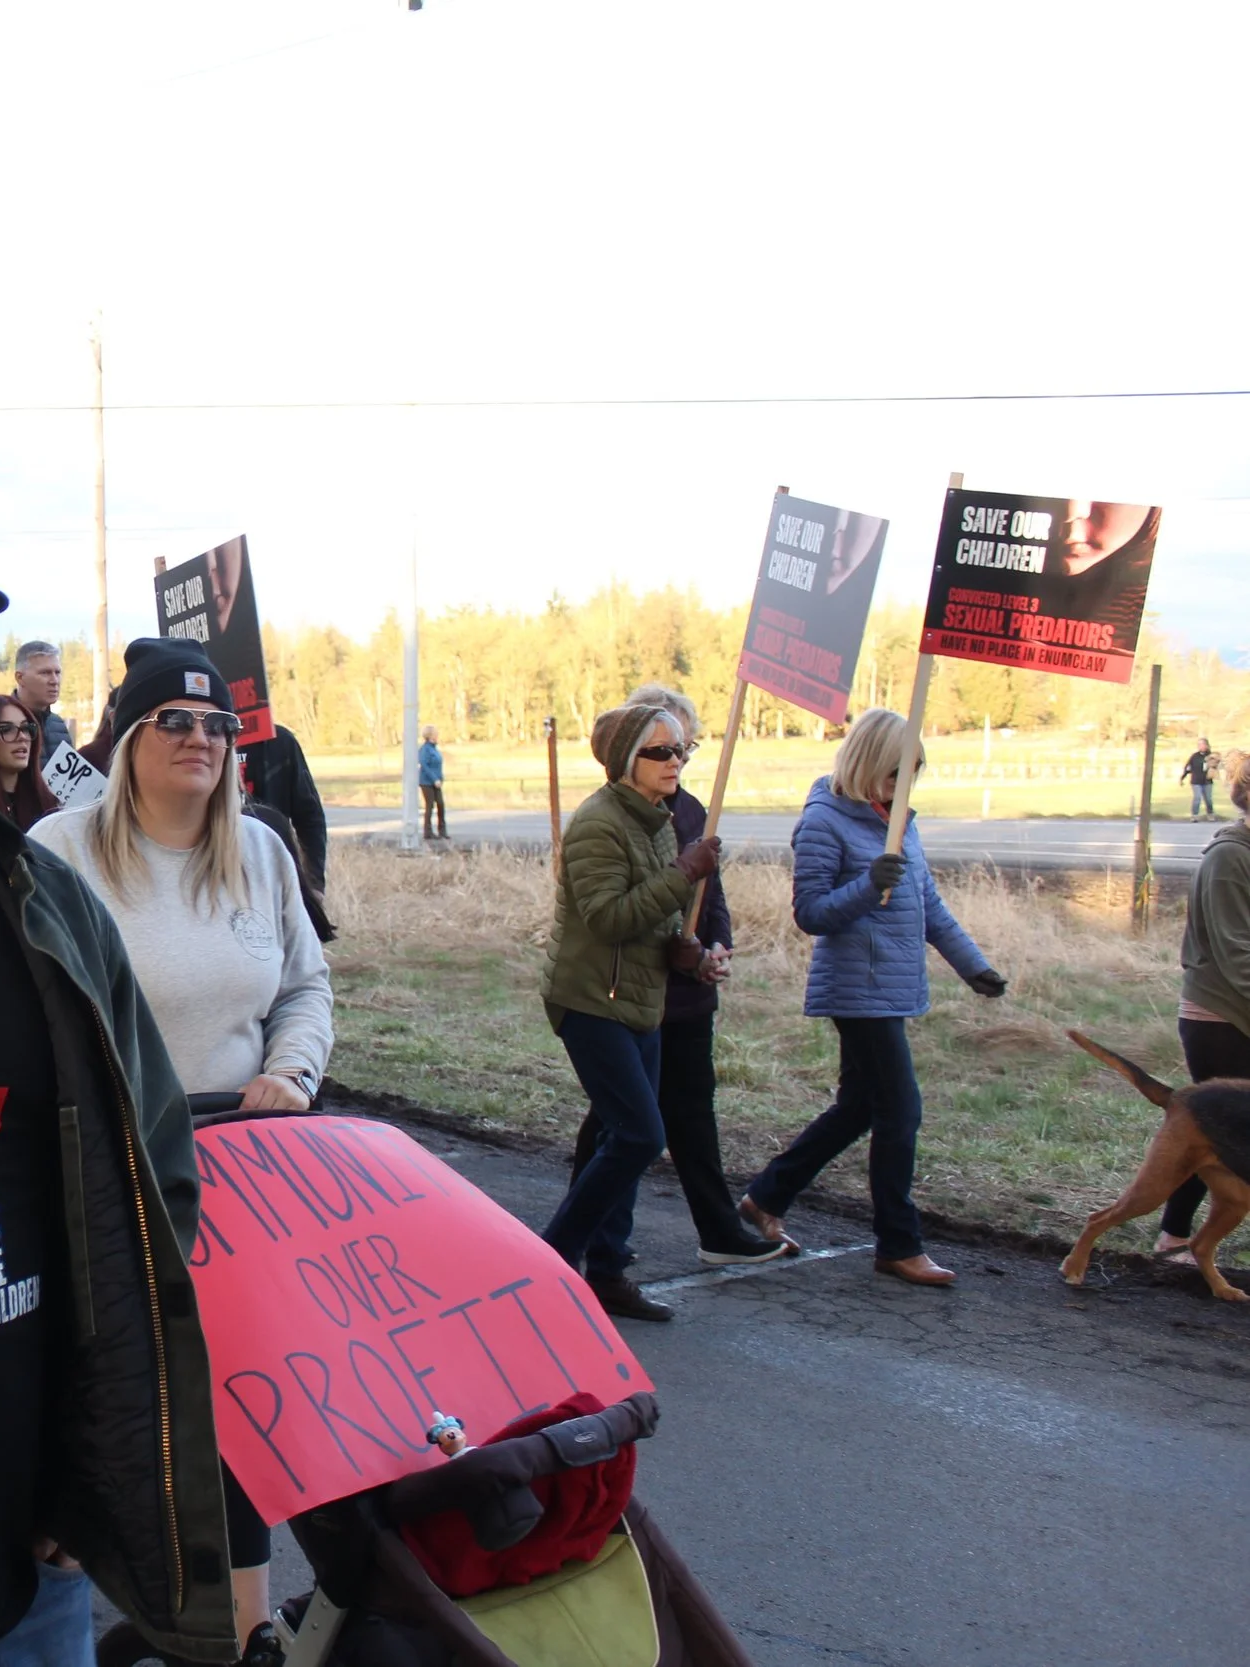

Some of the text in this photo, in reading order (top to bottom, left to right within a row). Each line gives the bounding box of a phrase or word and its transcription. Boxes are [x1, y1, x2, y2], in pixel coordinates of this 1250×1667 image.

[775, 513, 825, 554] SAVE OUR
[961, 505, 1053, 541] SAVE OUR
[767, 550, 818, 592] CHILDREN
[955, 538, 1047, 574] CHILDREN
[164, 575, 206, 619] SAVE OUR
[948, 587, 1041, 613] CONVICTED LEVEL 3
[943, 603, 1116, 651] SEXUAL PREDATORS
[940, 635, 1108, 673] HAVE NO PLACE IN ENUMCLAW
[55, 752, 92, 785] SVP
[296, 1234, 442, 1329] OVER
[224, 1276, 631, 1494] PROFIT!
